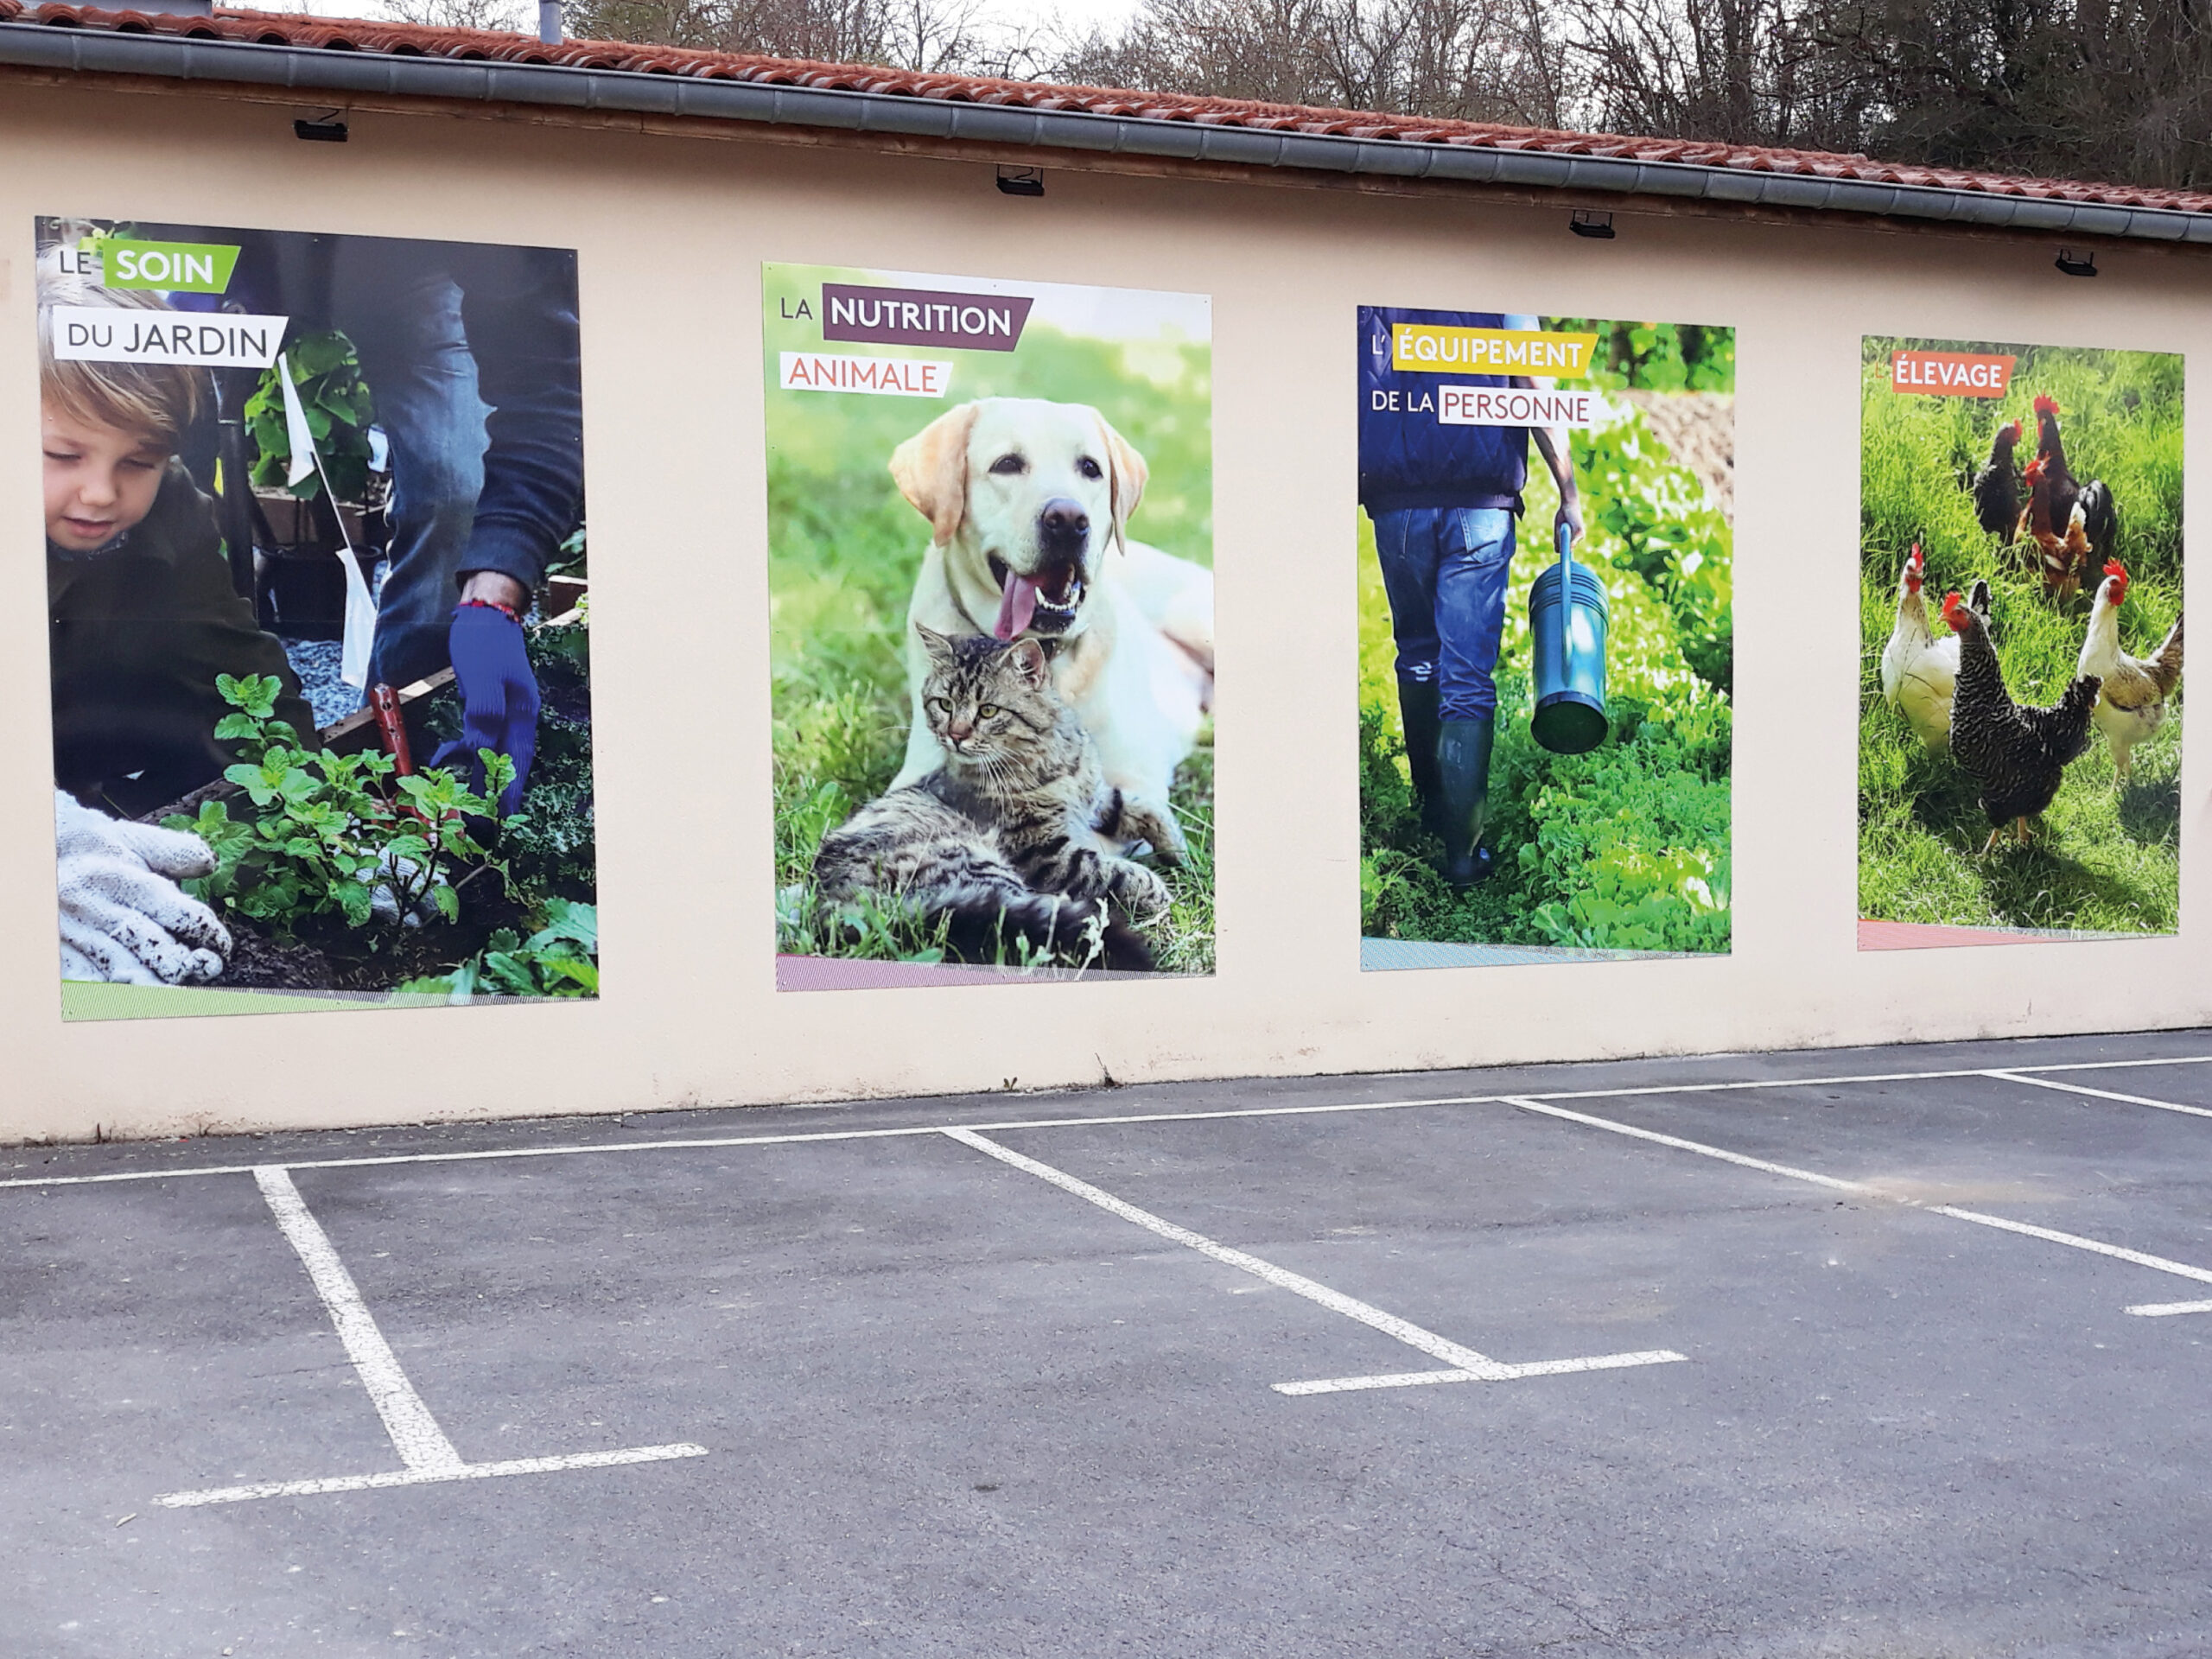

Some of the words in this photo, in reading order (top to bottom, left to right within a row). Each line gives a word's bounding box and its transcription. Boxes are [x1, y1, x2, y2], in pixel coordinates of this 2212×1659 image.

[60, 251, 92, 275] LE
[116, 250, 213, 284] SOIN
[781, 297, 813, 320] LA
[831, 296, 1011, 337] NUTRITION
[68, 323, 113, 347] DU
[124, 323, 267, 358] JARDIN
[1372, 334, 1386, 355] L'
[1399, 327, 1583, 368] ÉQUIPEMENT
[788, 358, 938, 392] ANIMALE
[1896, 353, 2002, 388] ÉLEVAGE
[1372, 390, 1400, 411] DE
[1408, 391, 1434, 413] LA
[1445, 392, 1589, 423] PERSONNE
